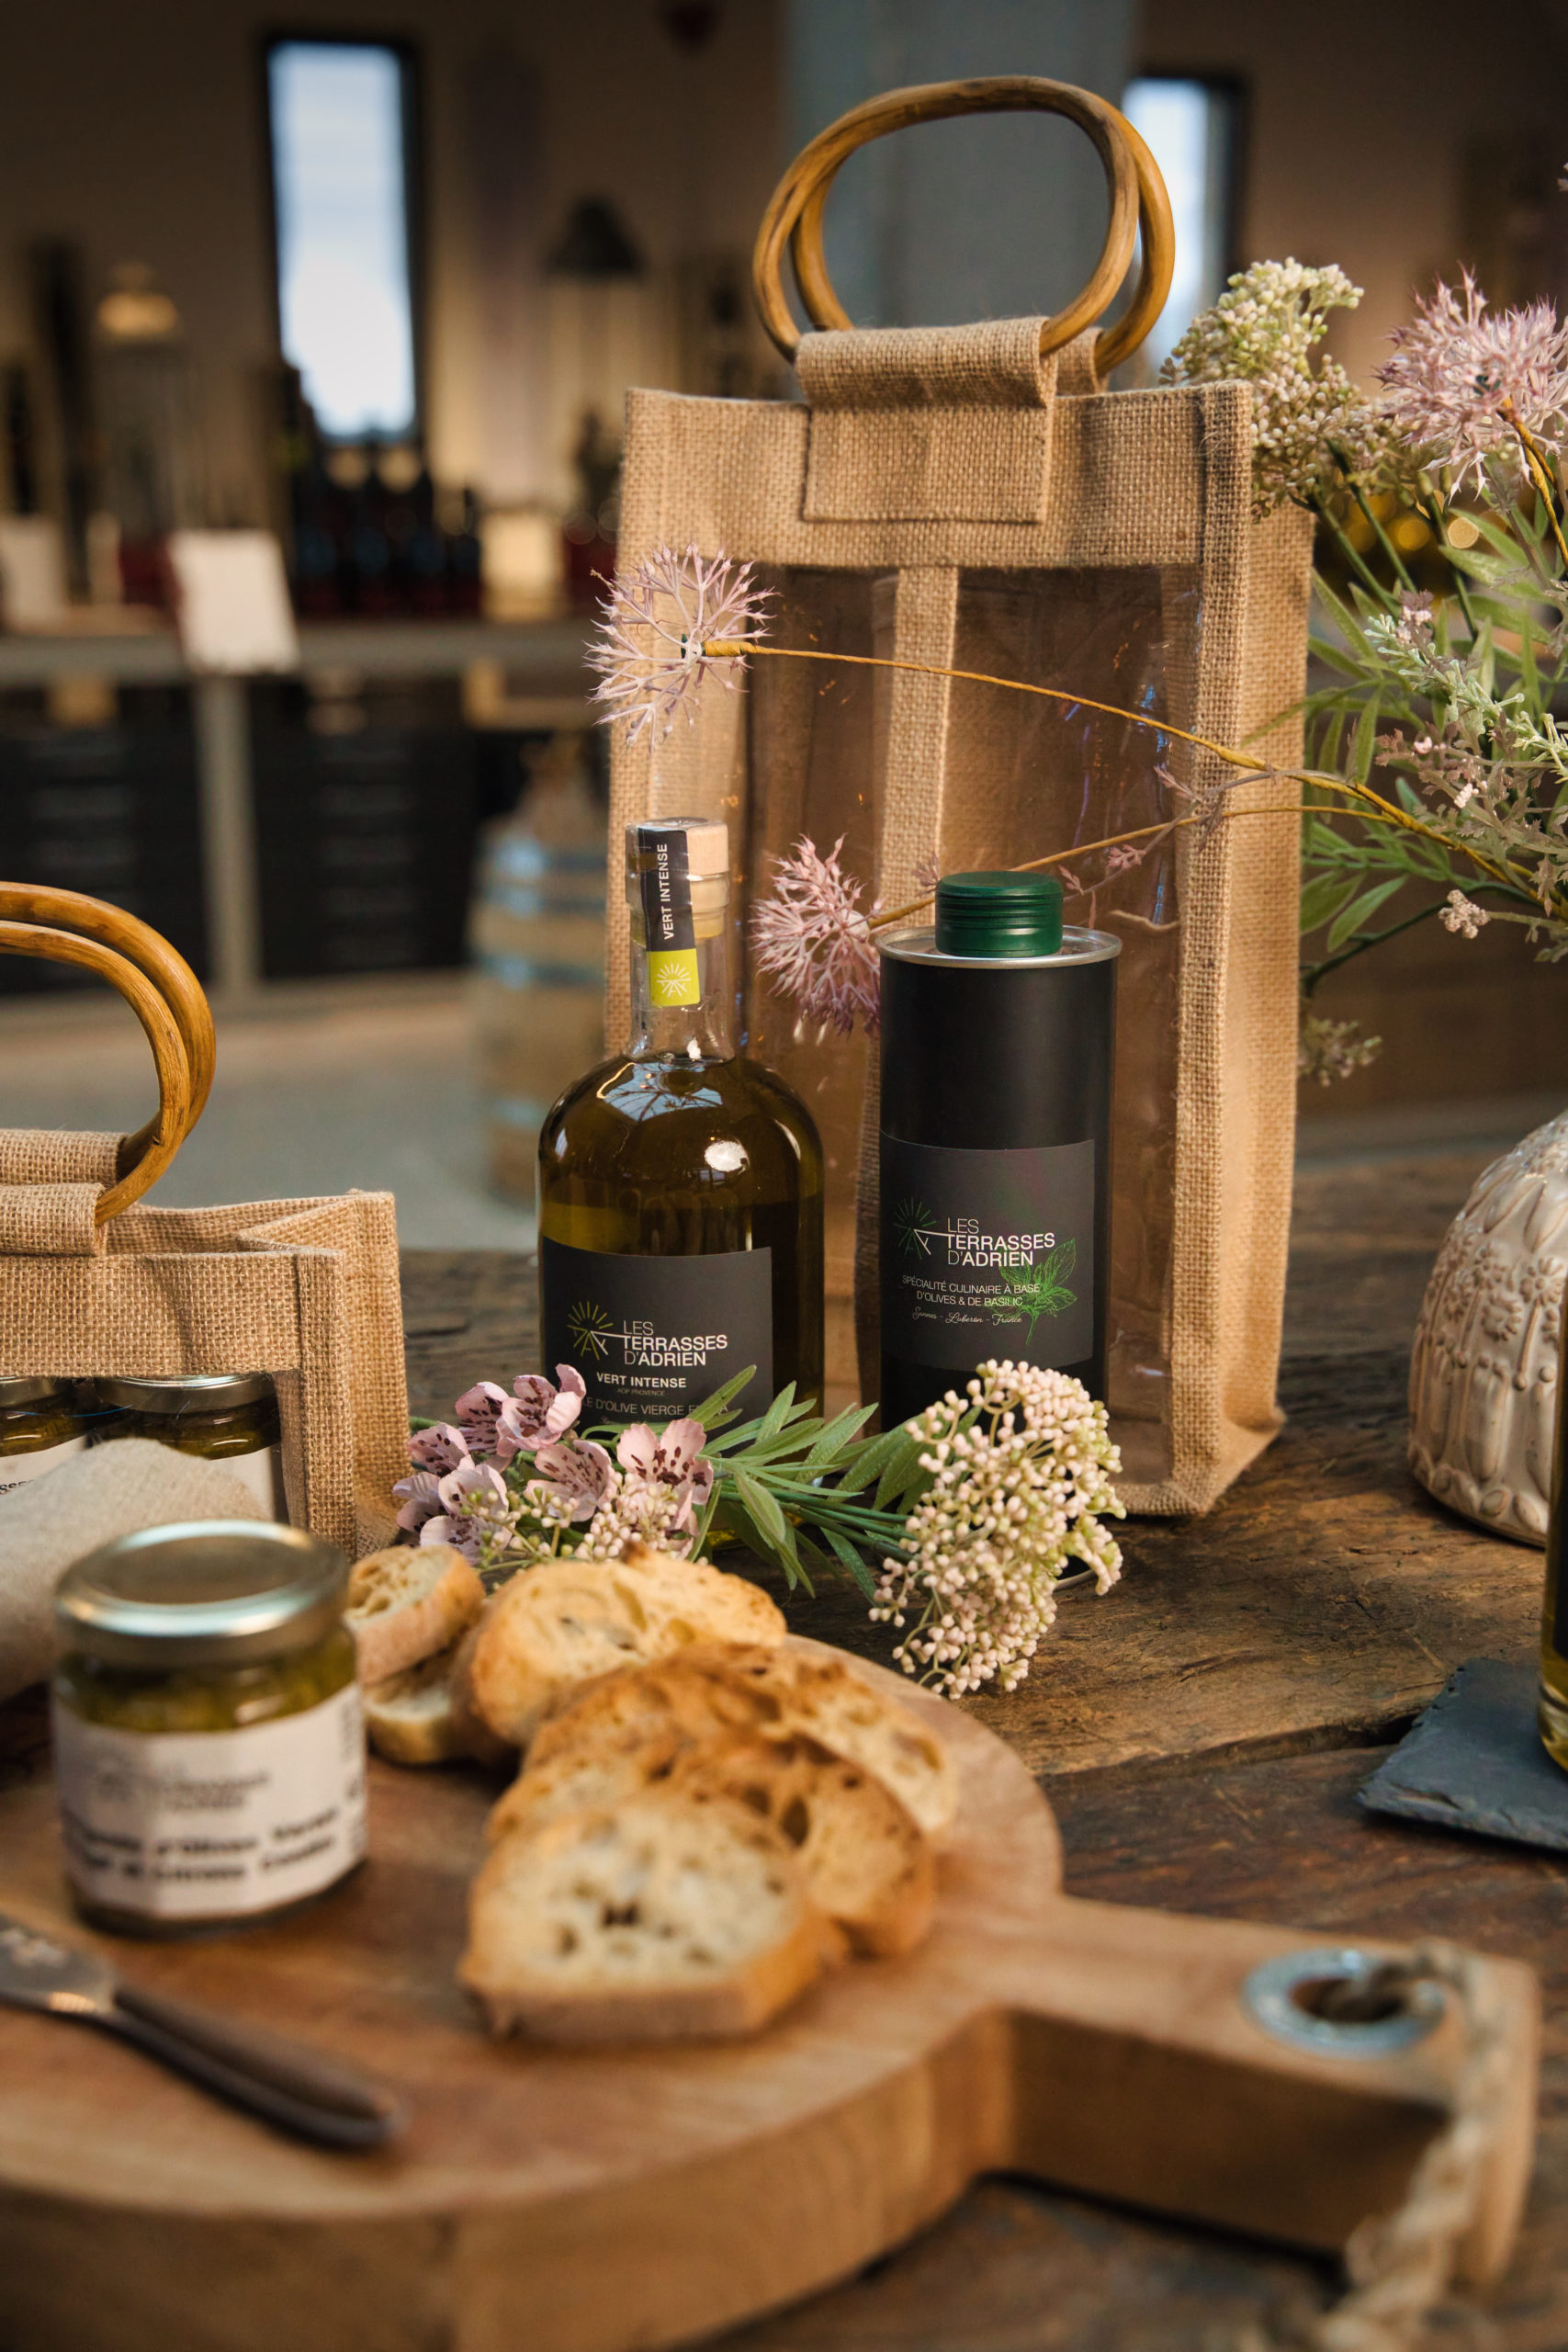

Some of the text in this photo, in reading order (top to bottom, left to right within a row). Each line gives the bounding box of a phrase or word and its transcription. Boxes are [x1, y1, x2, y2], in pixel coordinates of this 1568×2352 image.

[657, 843, 674, 940] VERT INTENSE
[948, 1217, 979, 1234] LES
[948, 1233, 1055, 1250] TERRASSES
[948, 1250, 1033, 1267] D'ADRIEN
[903, 1275, 1040, 1294] SPÉCIALITÉ CULINAIRE À BASE
[917, 1291, 1023, 1306] D'OLIVES & DE BASILIC
[945, 1312, 983, 1323] Luberon
[992, 1313, 1022, 1325] France
[624, 1320, 654, 1336] LES
[624, 1335, 728, 1351] TERRASSES
[625, 1351, 706, 1367] D'ADRIEN
[597, 1372, 687, 1388] VERT INTENSE
[596, 1399, 637, 1415] D'OLIVE
[641, 1406, 684, 1415] VIERGE
